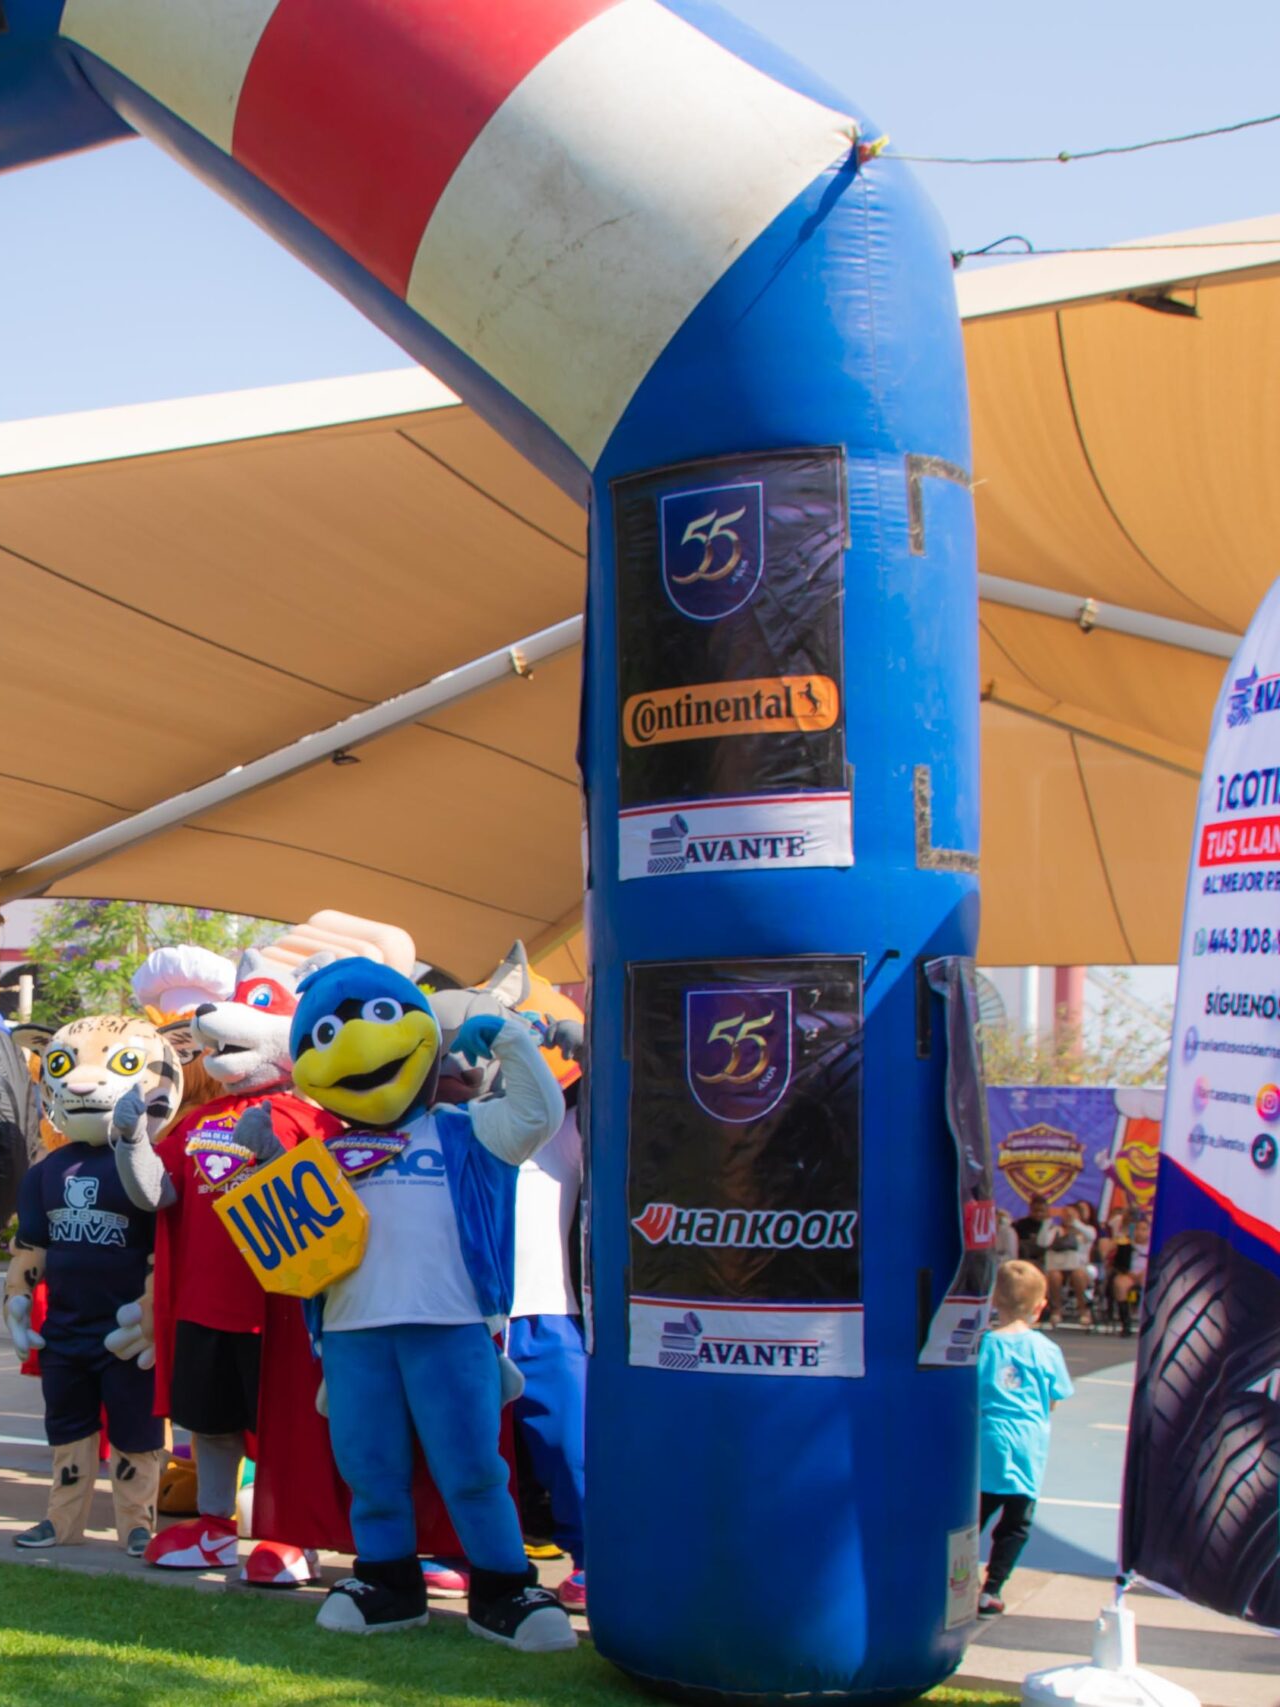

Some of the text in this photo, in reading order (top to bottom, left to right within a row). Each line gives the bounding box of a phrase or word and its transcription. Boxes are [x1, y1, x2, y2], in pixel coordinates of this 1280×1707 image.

[672, 505, 746, 584] 55
[631, 685, 793, 742] Continental
[685, 836, 806, 863] AVANTE
[1206, 828, 1237, 860] TUS
[1220, 871, 1264, 893] MEJOR
[1205, 985, 1280, 1020] SÍGUENO
[696, 1010, 775, 1084] 55
[227, 1160, 345, 1271] UVAQ
[697, 1343, 819, 1368] AVANTE
